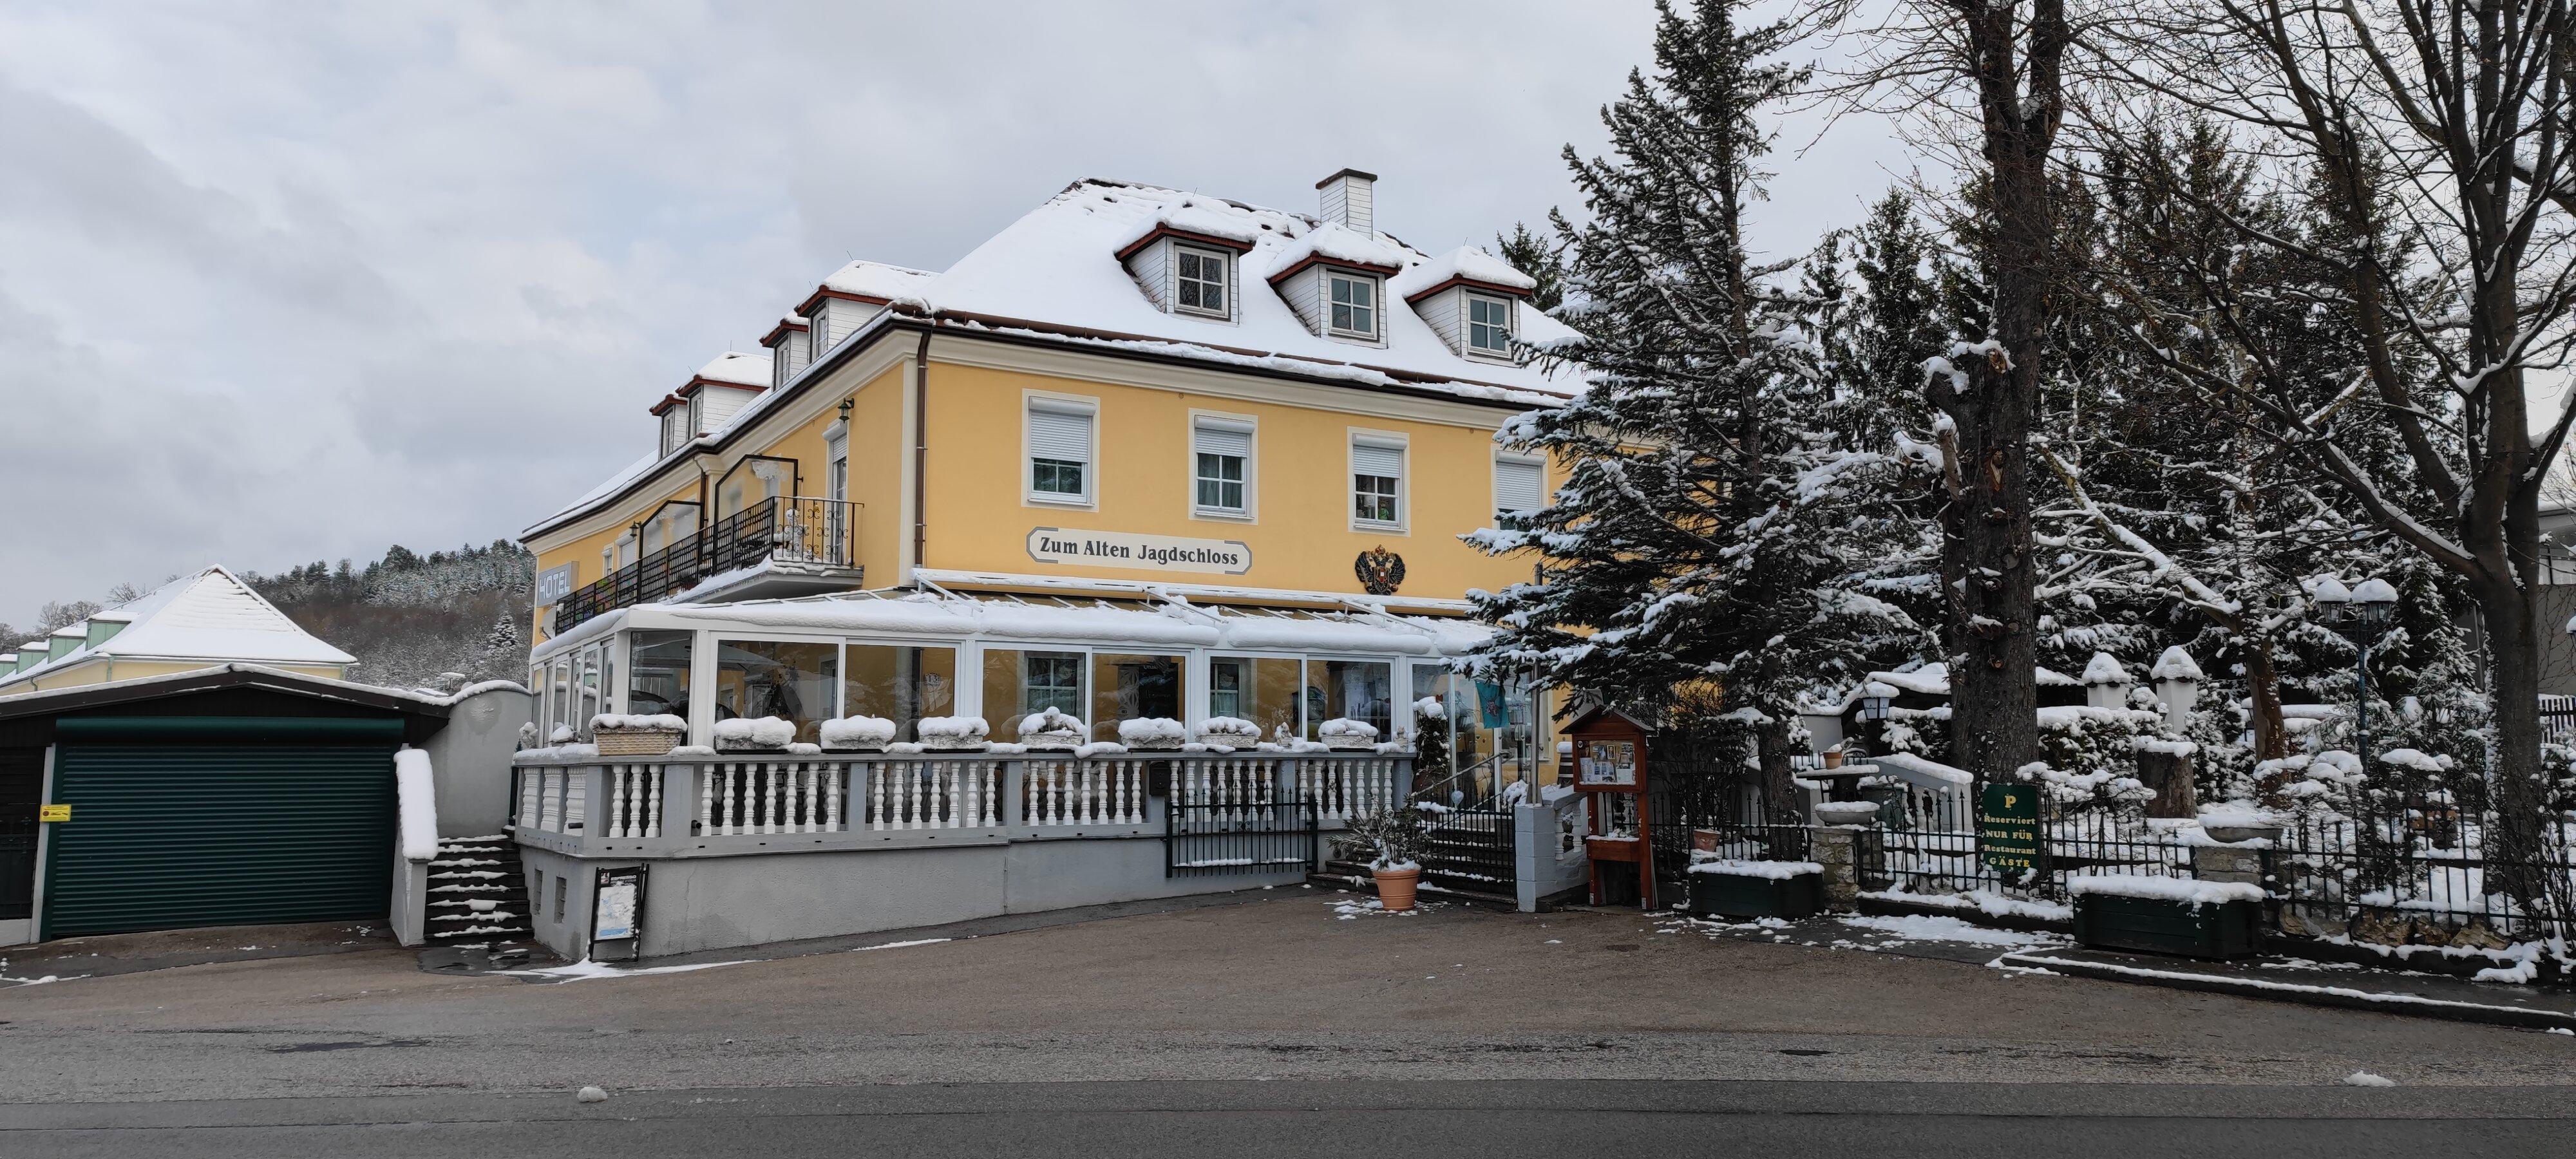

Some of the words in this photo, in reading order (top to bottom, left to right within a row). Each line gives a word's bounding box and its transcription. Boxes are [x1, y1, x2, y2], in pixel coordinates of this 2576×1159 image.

[1039, 536, 1079, 554] Zum
[1083, 540, 1130, 558] Alten
[1137, 544, 1238, 565] Jagdschloss
[538, 570, 571, 600] HOTEL
[2004, 795, 2017, 809] P
[1984, 815, 2036, 825] Reserviert
[1985, 830, 2008, 839] NUR
[2012, 829, 2033, 840] FÜR
[1984, 844, 2036, 855] Restaurant
[1989, 855, 2031, 867] GÄSTE
